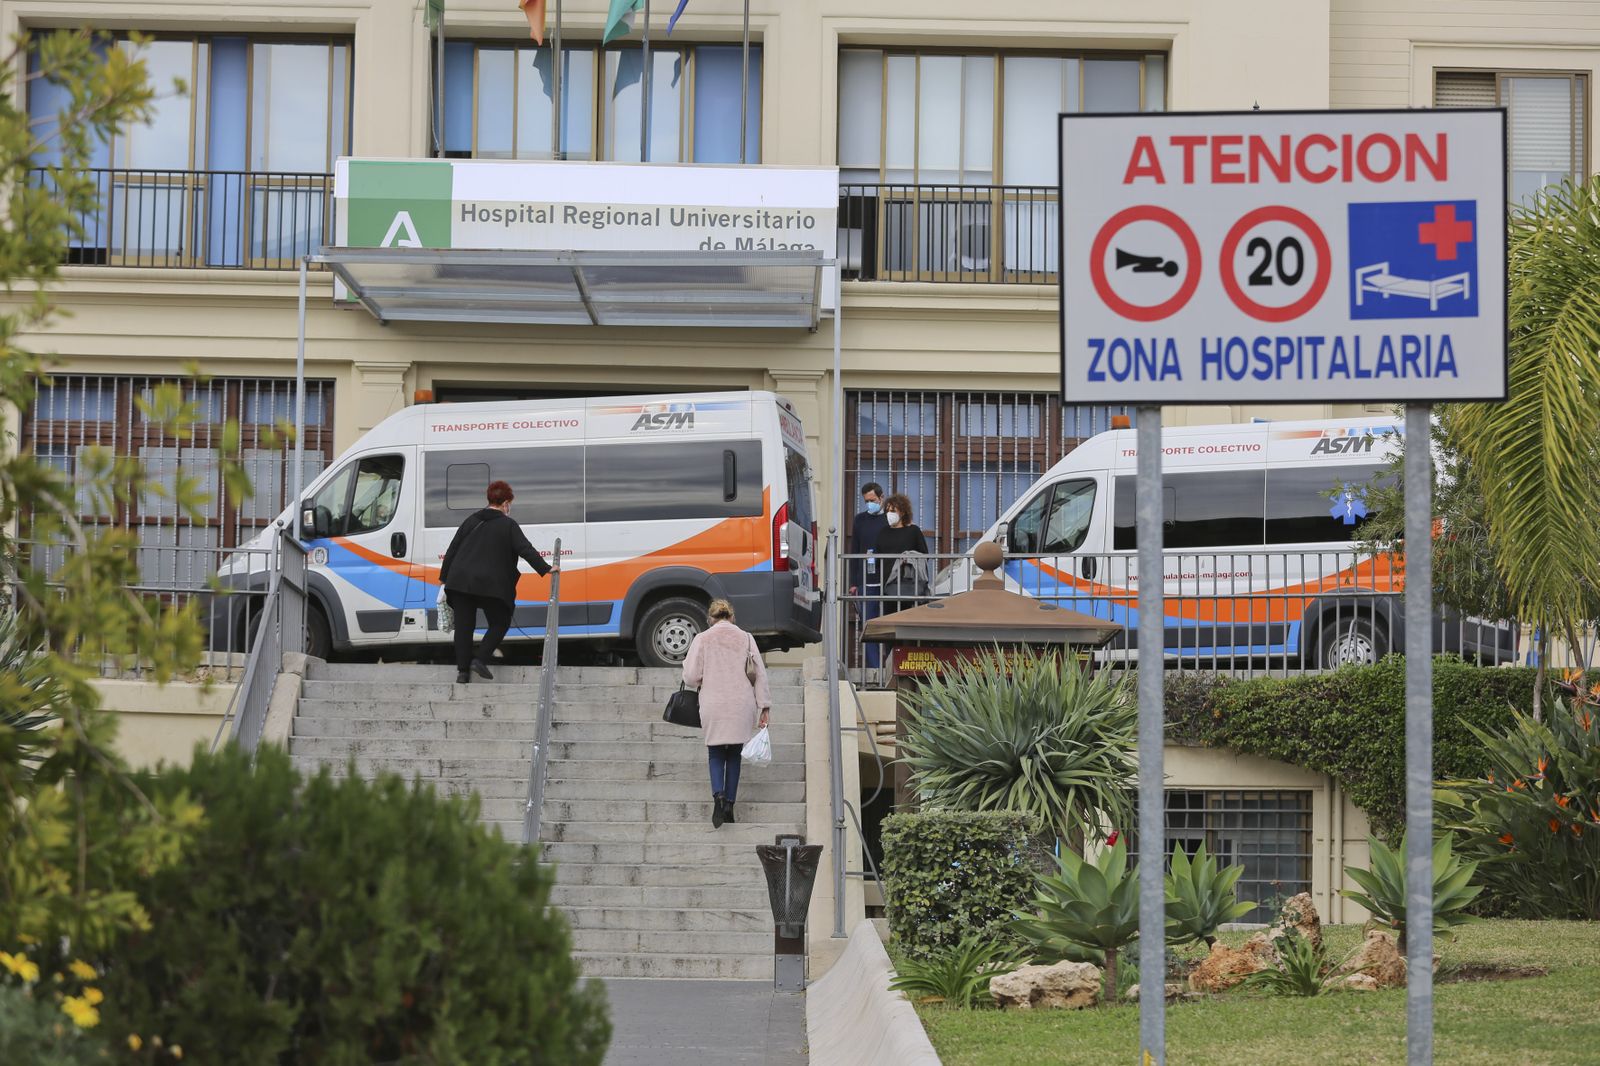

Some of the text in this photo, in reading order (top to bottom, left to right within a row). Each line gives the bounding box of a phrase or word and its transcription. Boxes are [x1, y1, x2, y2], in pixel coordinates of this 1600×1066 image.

[1122, 132, 1449, 185] ATENCION
[460, 203, 816, 230] Hospital Regional Universitario
[699, 236, 727, 251] de
[1246, 236, 1305, 287] 20
[1086, 334, 1459, 383] ZONA HOSPITALARIA
[432, 419, 579, 433] TRANSPORTE COLECTIVO
[630, 412, 695, 431] ASM
[1121, 443, 1261, 457] TRPORTE COLECTIVO
[1310, 436, 1374, 455] ASM
